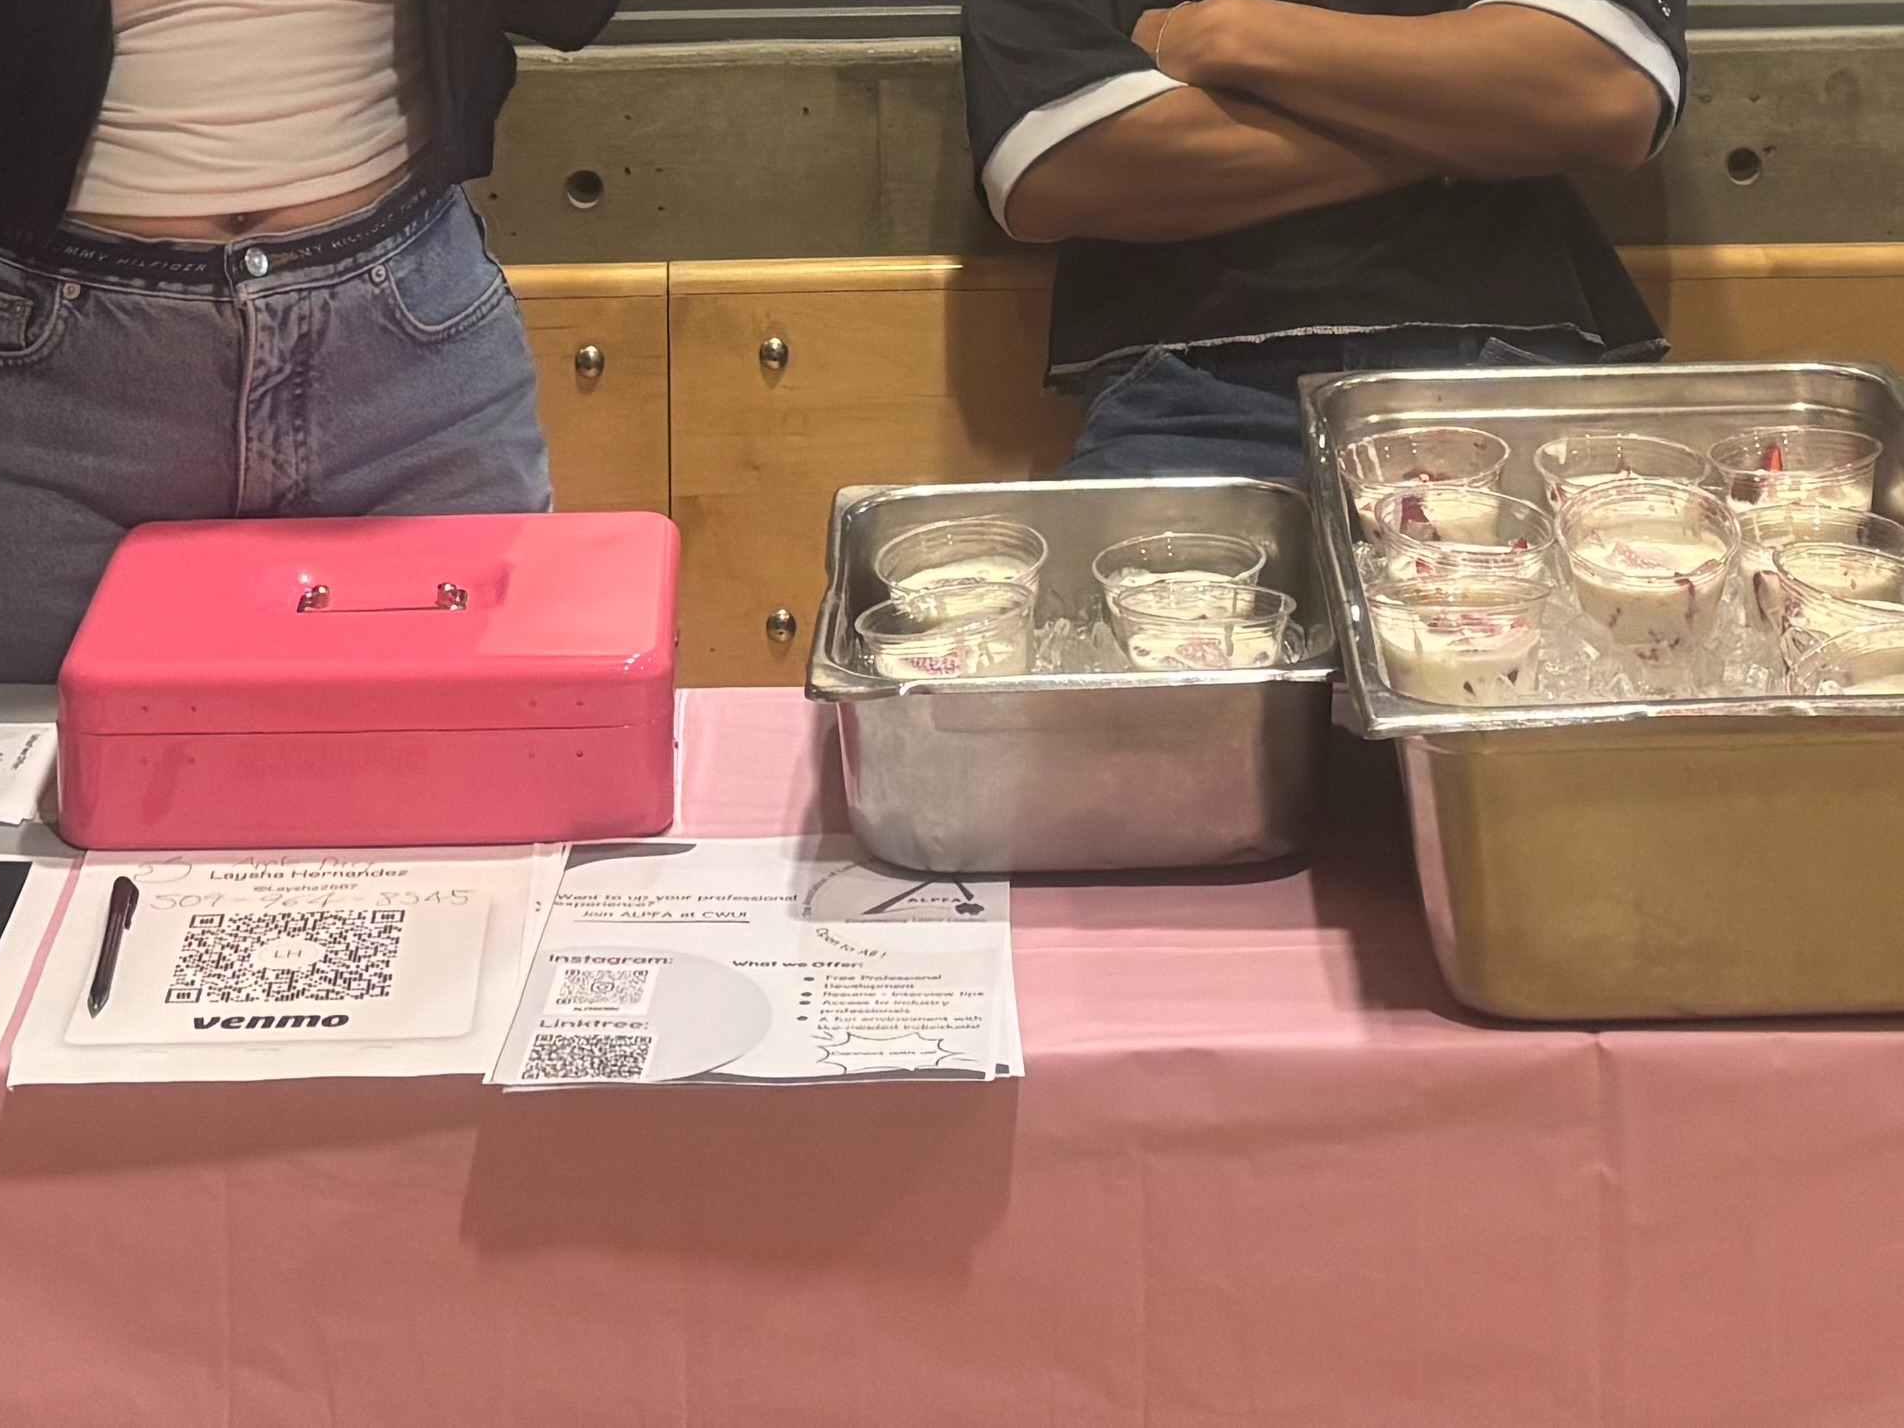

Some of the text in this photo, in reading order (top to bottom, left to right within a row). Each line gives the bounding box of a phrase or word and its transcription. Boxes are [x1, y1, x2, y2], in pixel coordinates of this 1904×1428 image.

[210, 869, 408, 881] Laysha Hernandez
[556, 894, 598, 902] Want
[628, 894, 650, 903] up
[655, 894, 692, 903] your
[697, 893, 798, 903] professional
[620, 911, 673, 919] ALPFA
[274, 948, 302, 959] LH
[549, 954, 673, 965] Instagram:
[194, 1014, 350, 1031] venmo
[540, 1019, 649, 1029] Linktree:
